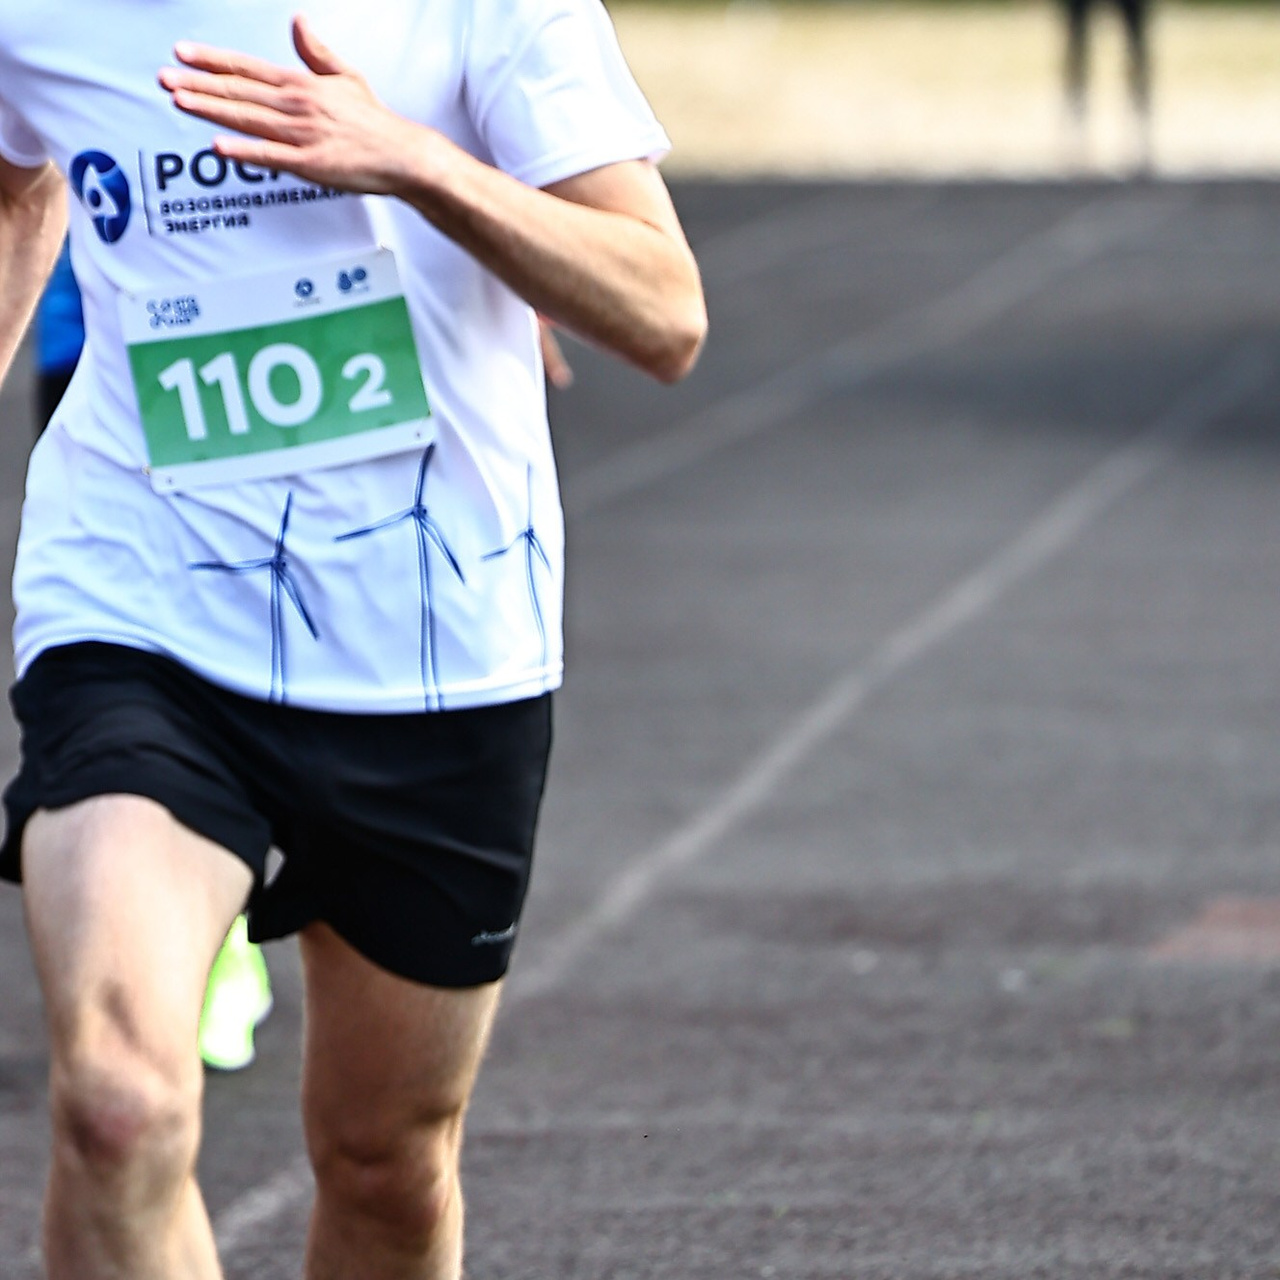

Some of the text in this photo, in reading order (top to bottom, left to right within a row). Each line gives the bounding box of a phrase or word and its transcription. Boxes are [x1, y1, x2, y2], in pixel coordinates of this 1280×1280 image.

[155, 149, 280, 191] РОС
[164, 213, 250, 233] ЭНЕРГИЯ
[157, 342, 393, 441] 110 2
